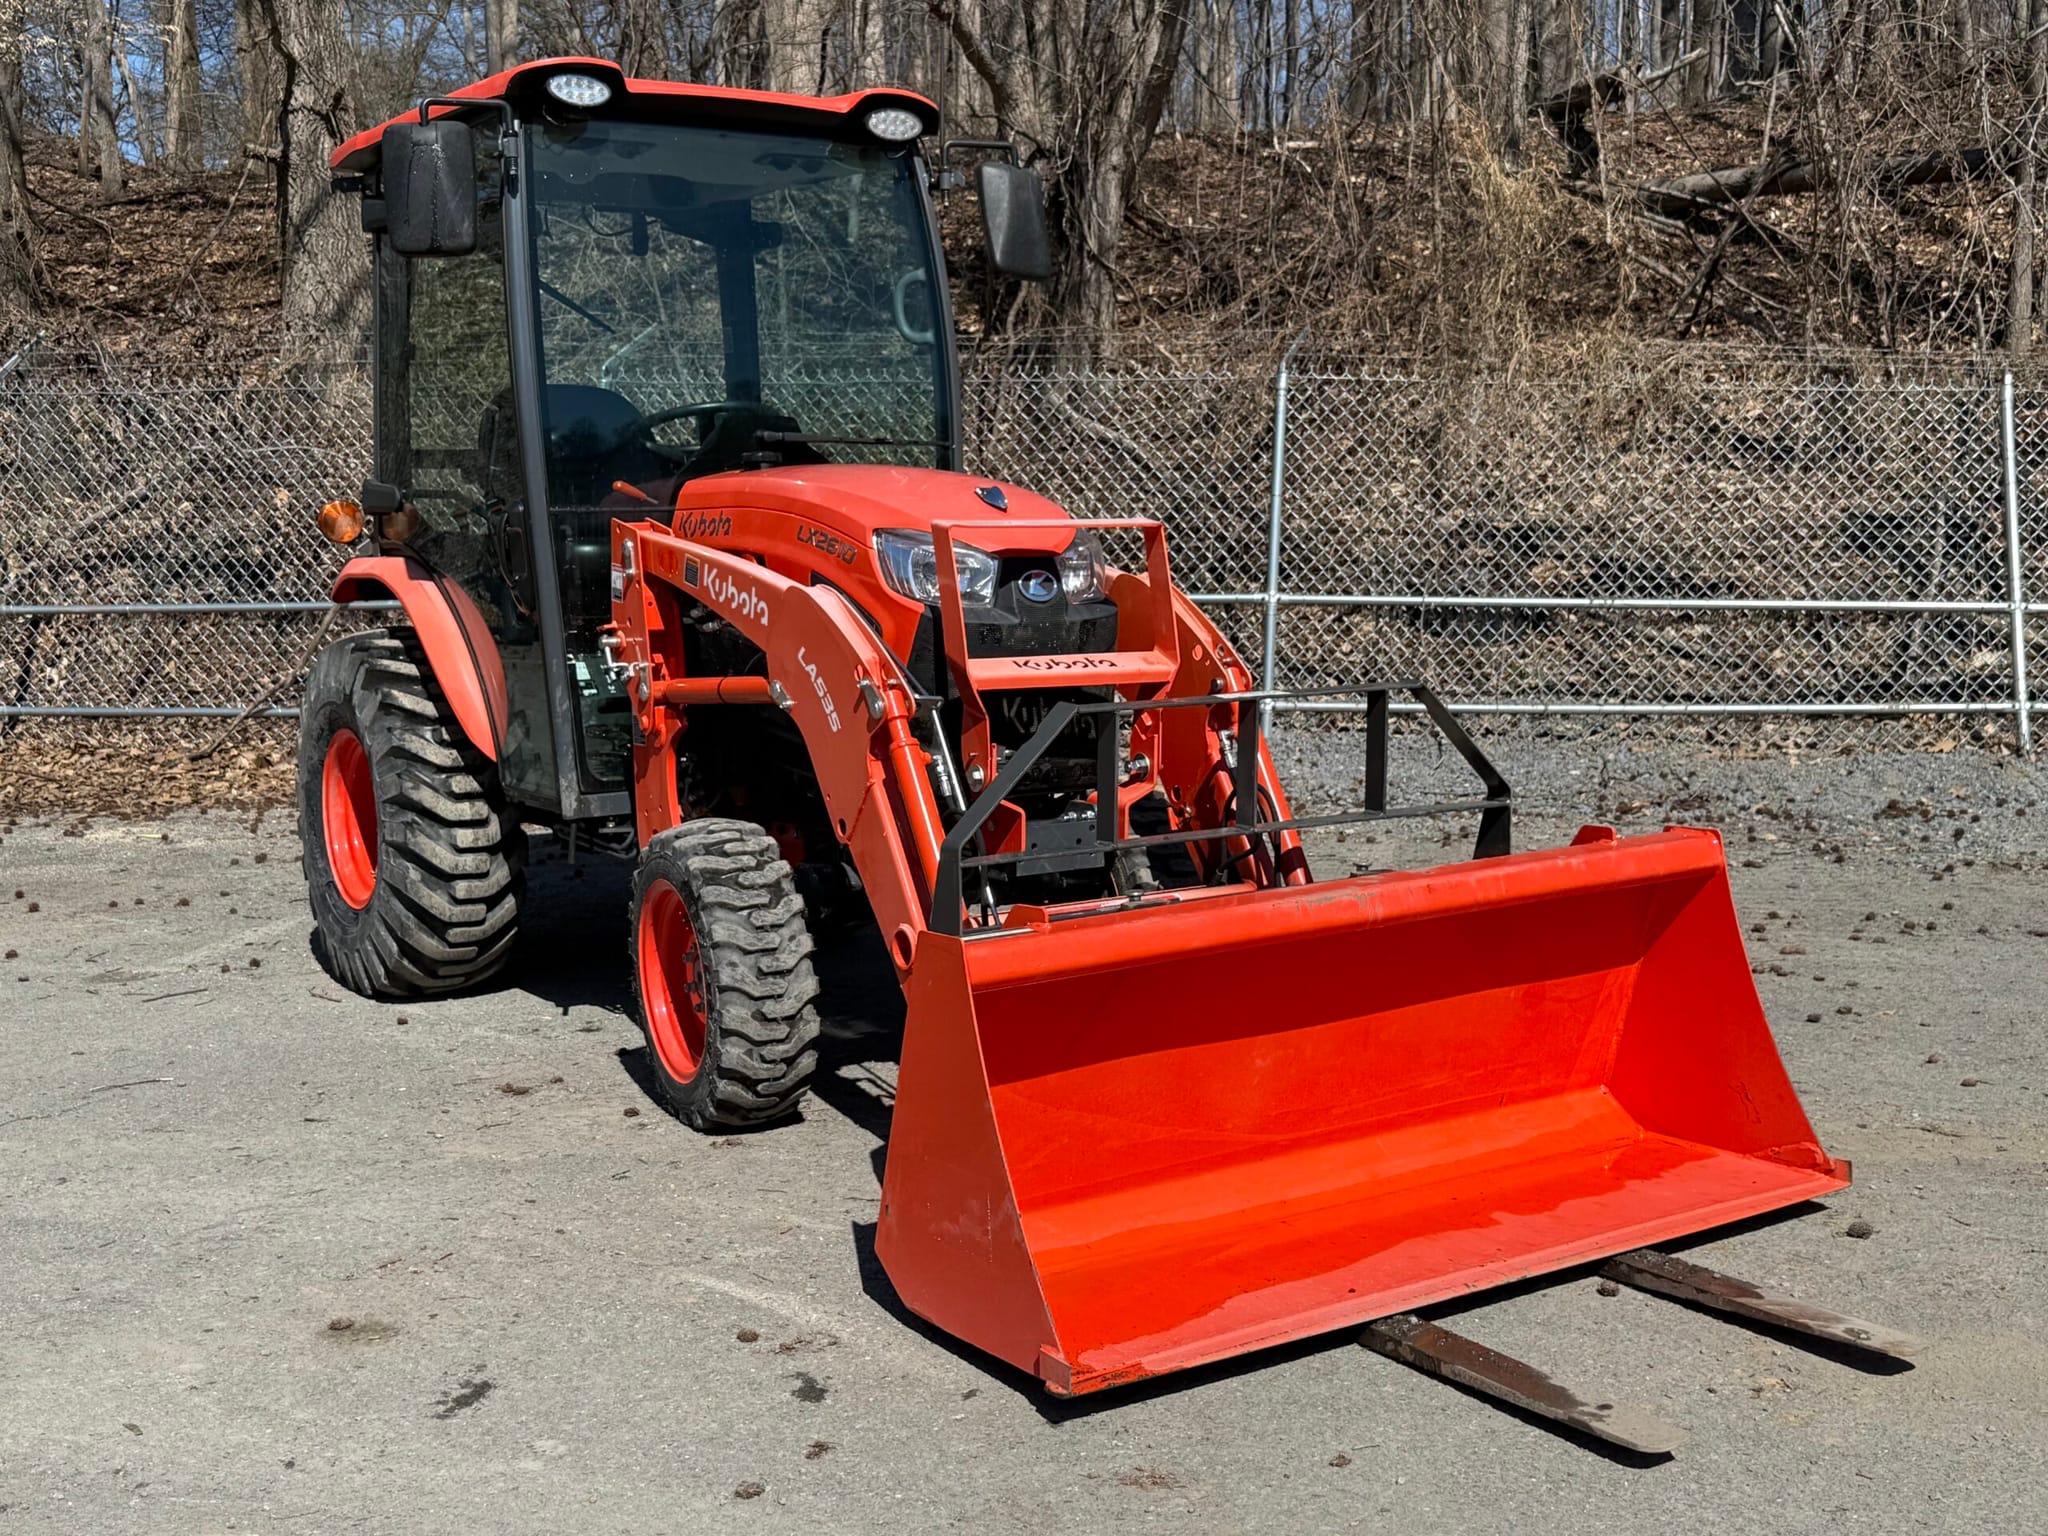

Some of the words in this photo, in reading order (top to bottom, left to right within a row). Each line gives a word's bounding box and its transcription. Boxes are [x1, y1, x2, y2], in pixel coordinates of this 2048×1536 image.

[679, 510, 732, 538] Kubota
[796, 523, 858, 565] LX2610
[703, 562, 769, 628] Kubota
[1012, 657, 1118, 671] Kubota
[797, 645, 842, 734] LA535
